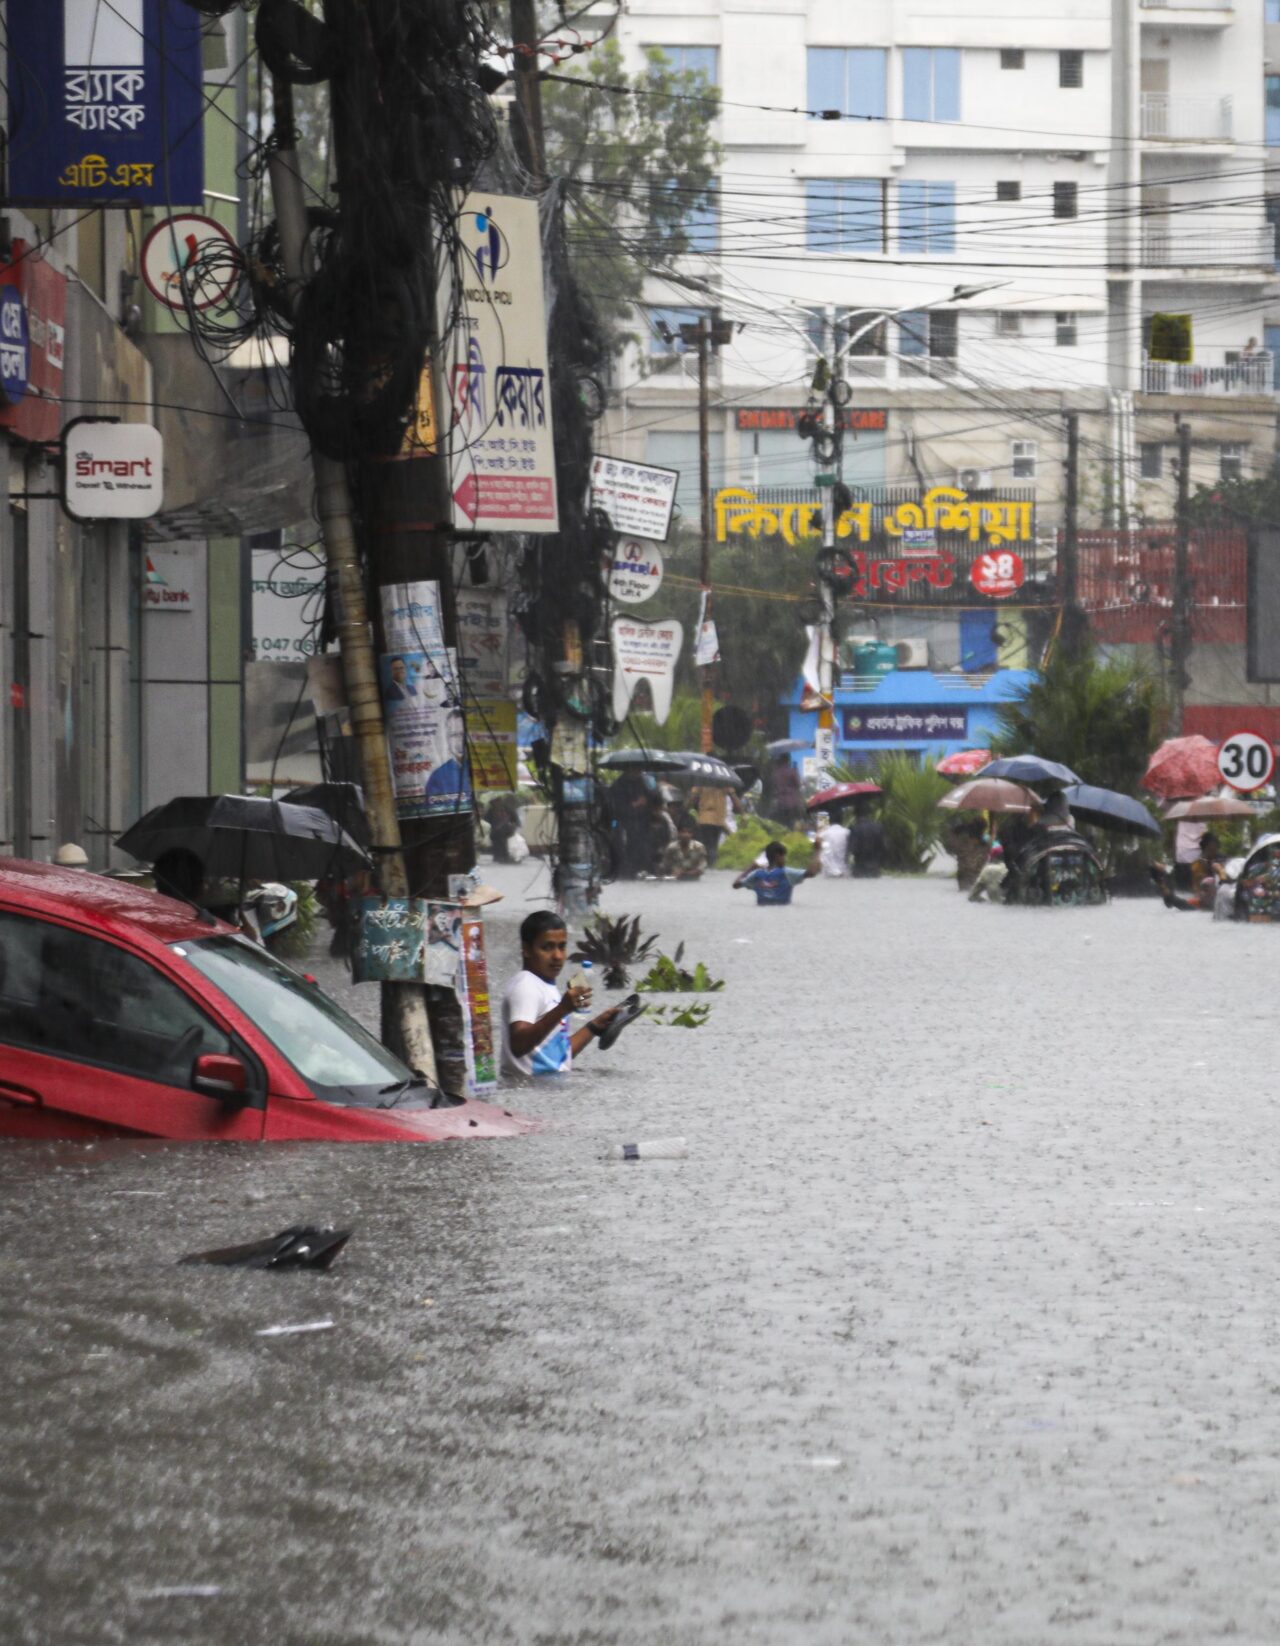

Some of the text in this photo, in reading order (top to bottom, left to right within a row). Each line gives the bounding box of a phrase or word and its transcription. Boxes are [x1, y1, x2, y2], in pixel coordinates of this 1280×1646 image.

[65, 70, 145, 102] ব্র্যাক
[65, 105, 145, 130] ব্যাংক
[75, 457, 152, 477] smart
[884, 486, 1033, 545] এশিয়া
[981, 554, 1015, 579] ২৪
[1223, 743, 1268, 778] 30
